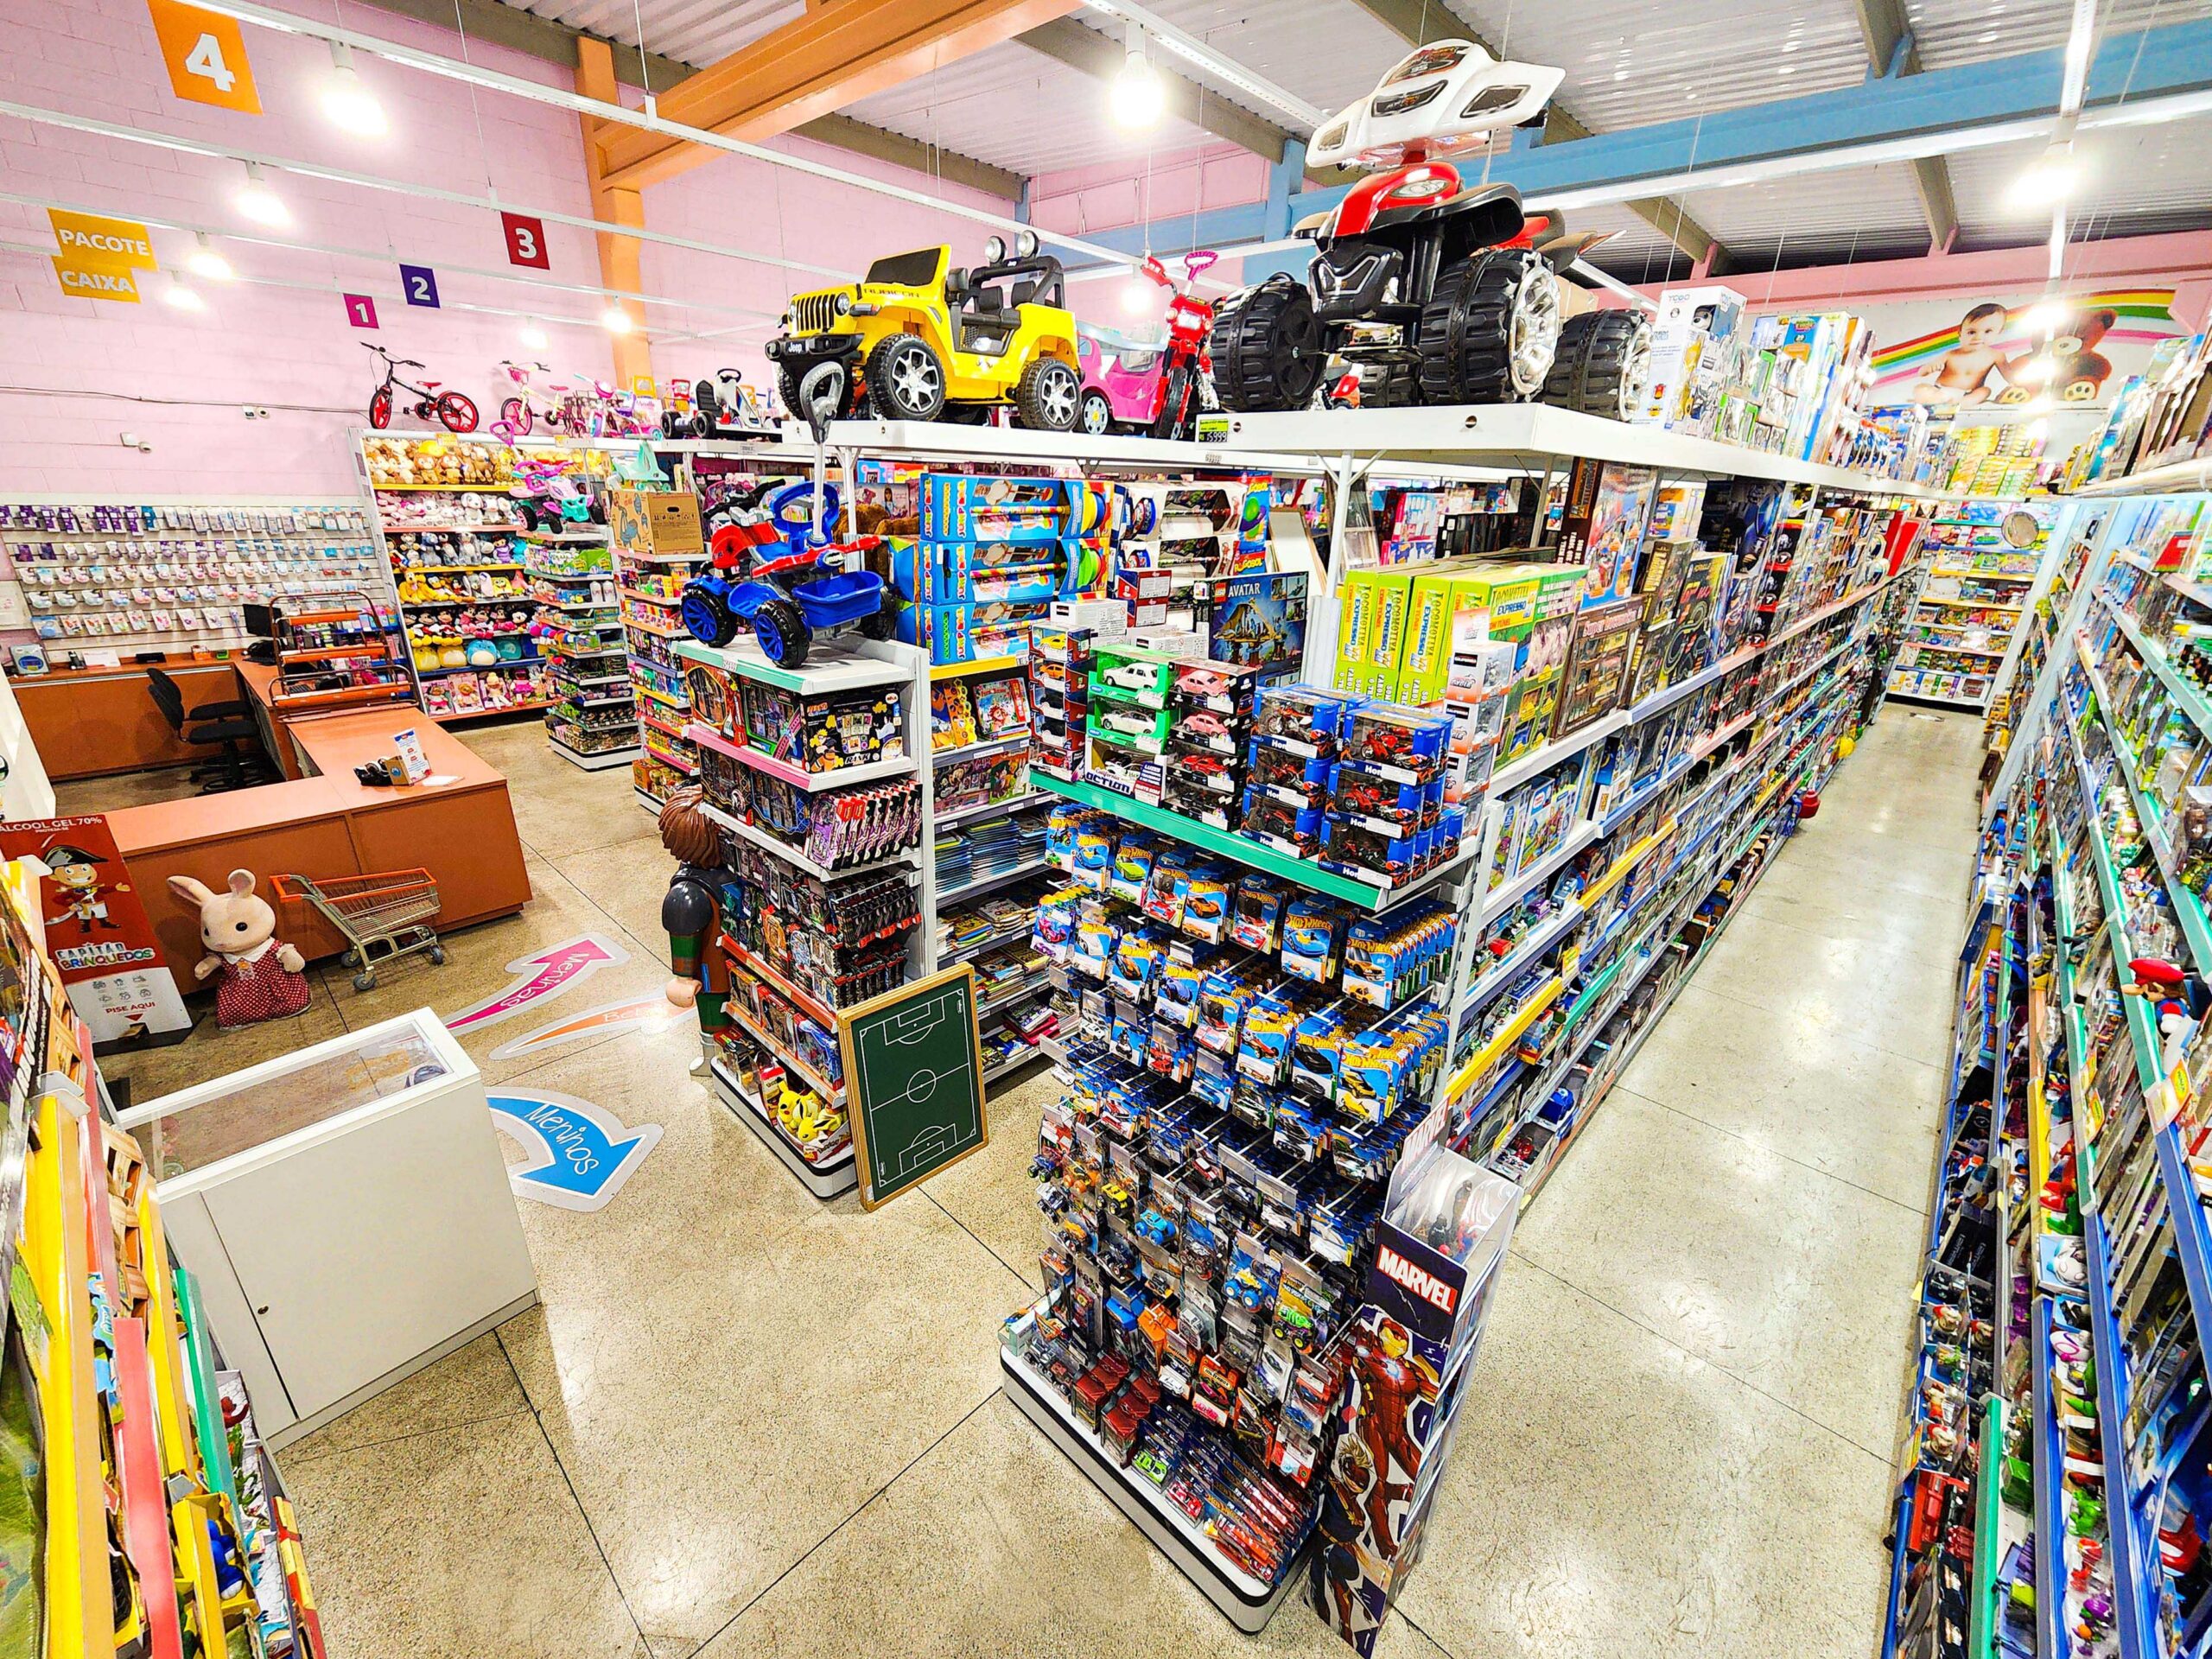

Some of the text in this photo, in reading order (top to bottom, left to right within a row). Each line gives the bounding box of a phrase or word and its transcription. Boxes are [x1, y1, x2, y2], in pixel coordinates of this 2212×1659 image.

[185, 33, 236, 92] 4
[58, 228, 151, 257] PACOTE
[515, 227, 537, 259] 3
[61, 270, 136, 294] CAIXA
[411, 276, 431, 301] 2
[863, 287, 920, 299] RUBICON
[355, 303, 369, 323] 1
[787, 342, 804, 354] Jeep
[1228, 582, 1261, 598] AVATAR
[1381, 602, 1392, 652] EXPRESSO
[1417, 606, 1431, 656] EXPRESSO
[1271, 739, 1287, 750] Hon
[1365, 765, 1382, 777] Hon
[1267, 788, 1280, 799] Hon
[52, 818, 77, 829] GEL
[77, 817, 103, 826] 70%
[1350, 817, 1367, 829] Hon
[1342, 867, 1359, 878] Hon
[1288, 917, 1332, 931] HOT WHEELS
[60, 950, 154, 969] BRINQUEDOS
[499, 952, 591, 1008] Meninas
[105, 1001, 156, 1014] PISE AQUI
[1346, 1054, 1391, 1074] HOT WHEELS
[524, 1103, 599, 1175] Meninos
[1377, 1249, 1452, 1313] MARVEL
